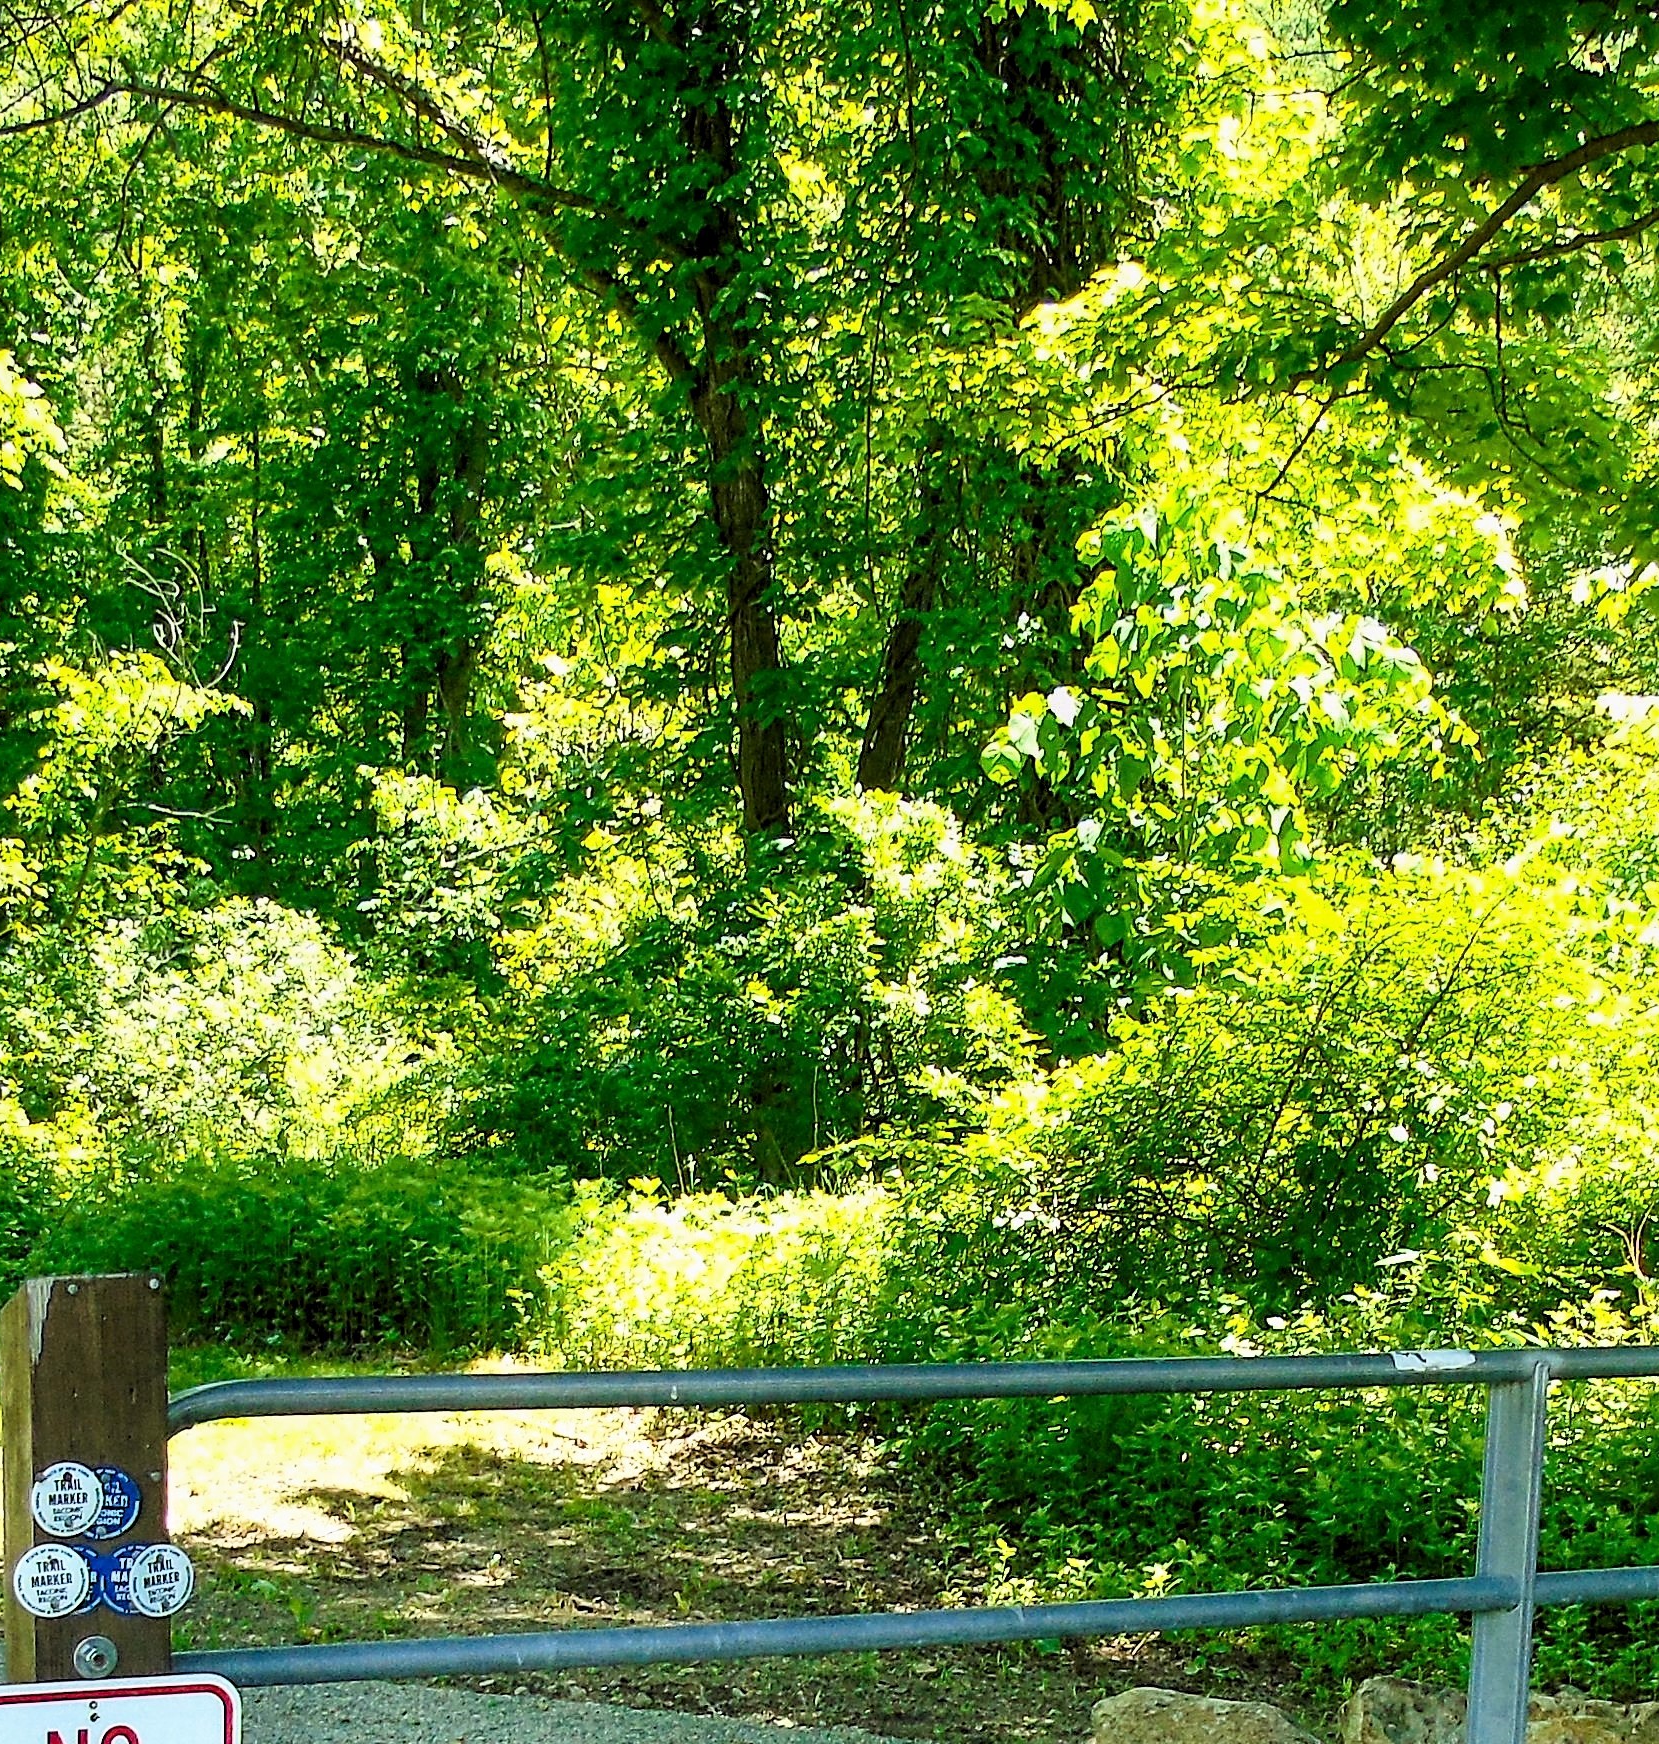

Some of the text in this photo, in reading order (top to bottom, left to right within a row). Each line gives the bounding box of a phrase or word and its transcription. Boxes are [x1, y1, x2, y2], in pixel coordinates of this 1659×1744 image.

[54, 1479, 82, 1491] TRAIL
[48, 1492, 88, 1506] MARKER
[36, 1559, 66, 1573] TRAIL
[148, 1559, 174, 1573] TRAIL
[31, 1573, 72, 1588] MARKER
[143, 1572, 180, 1588] MARKER
